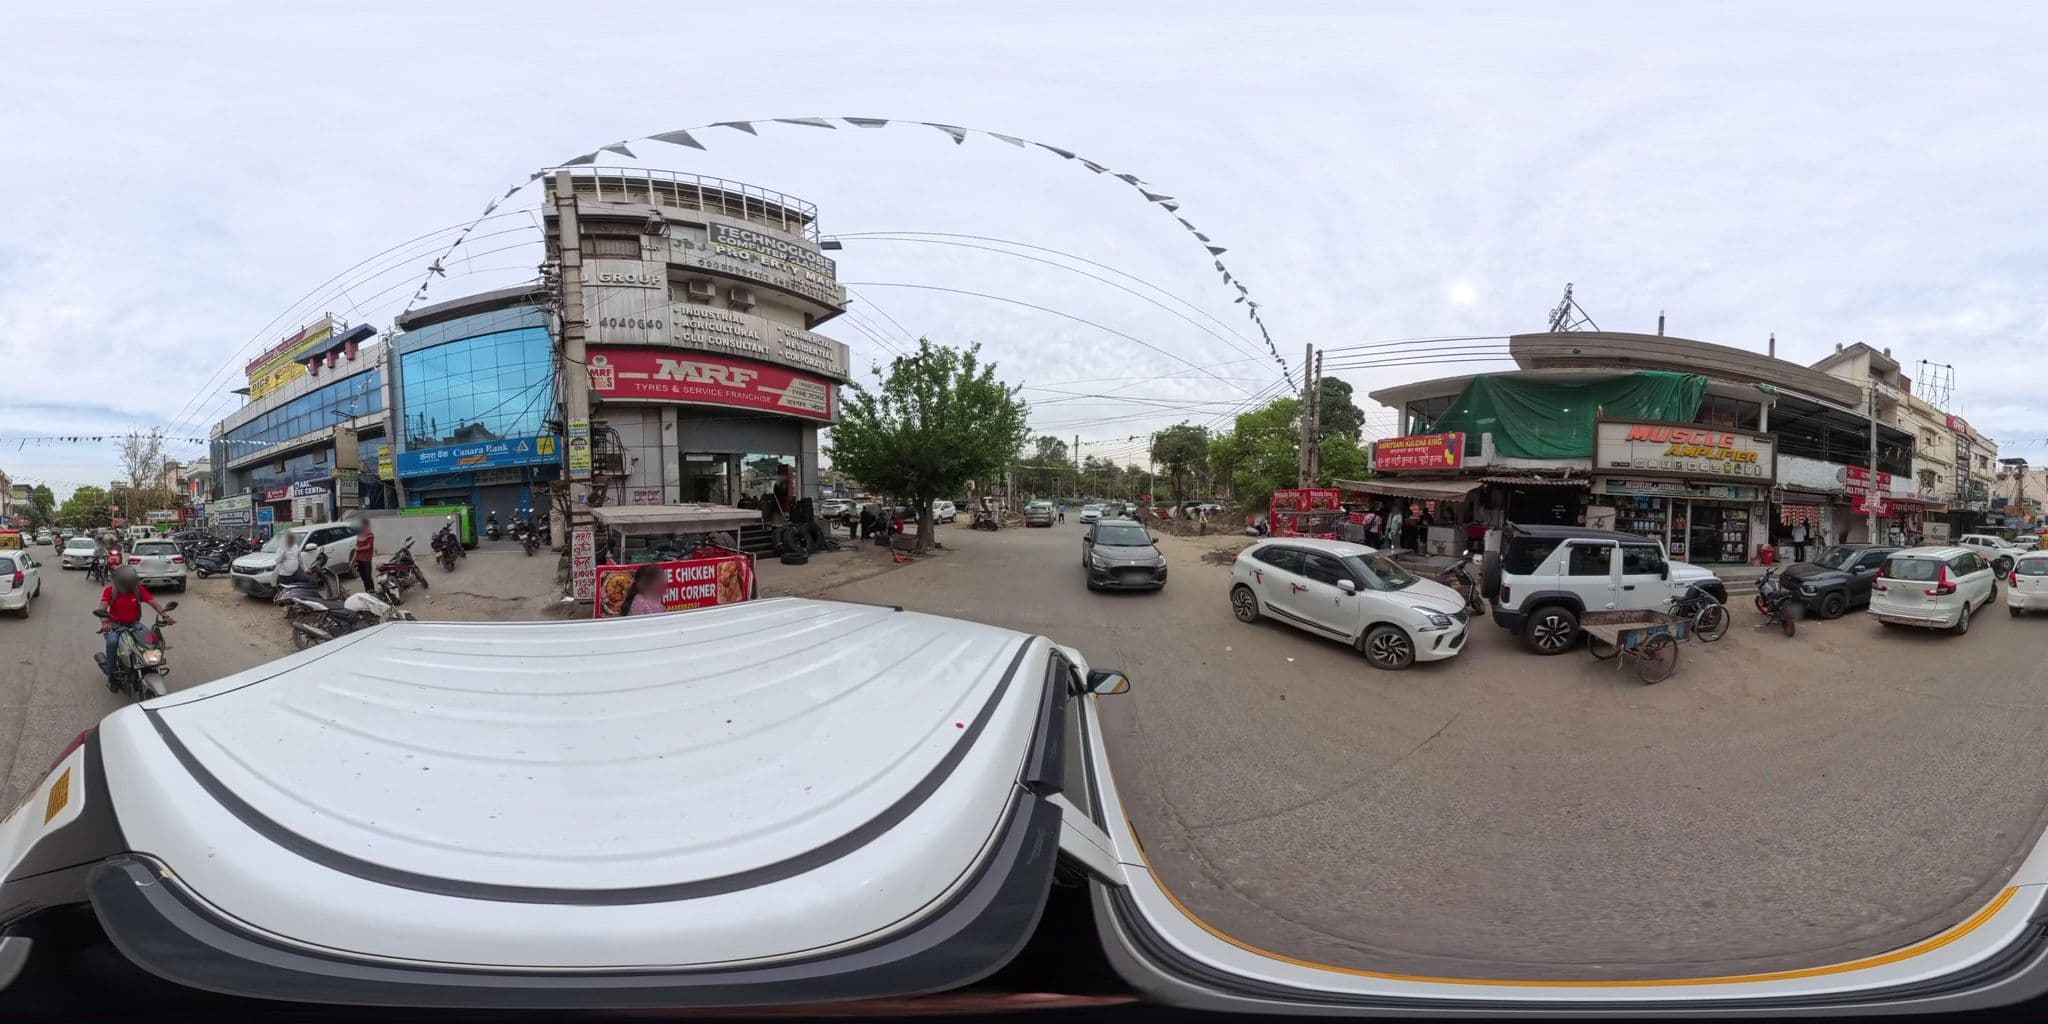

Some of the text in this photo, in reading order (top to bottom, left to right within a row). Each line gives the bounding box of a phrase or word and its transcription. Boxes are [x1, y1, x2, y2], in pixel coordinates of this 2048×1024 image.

[716, 225, 833, 270] TECHNOGLOBE
[718, 236, 787, 260] COMPUTER
[600, 272, 661, 286] GROUP
[715, 245, 799, 276] PROERTY
[806, 270, 839, 292] MART
[681, 306, 746, 326] INDUSTRIAL
[682, 319, 761, 341] AGRICULTURAL
[784, 328, 834, 350] COMMERCIAL
[683, 332, 771, 355] CLU CONSULTANT
[785, 340, 834, 361] RESIDENTIAL
[785, 351, 827, 371] CORPORATE
[653, 358, 758, 389] MRF
[635, 383, 668, 392] TYRES
[683, 387, 723, 397] SERVICE
[725, 390, 773, 404] FRANCHISE
[1626, 424, 1735, 449] MUSCLE
[453, 446, 484, 457] Canara
[485, 443, 508, 453] Bank
[1664, 444, 1759, 464] AMPLIFIER
[676, 565, 715, 583] CHICKEN
[681, 583, 716, 600] CORNER
